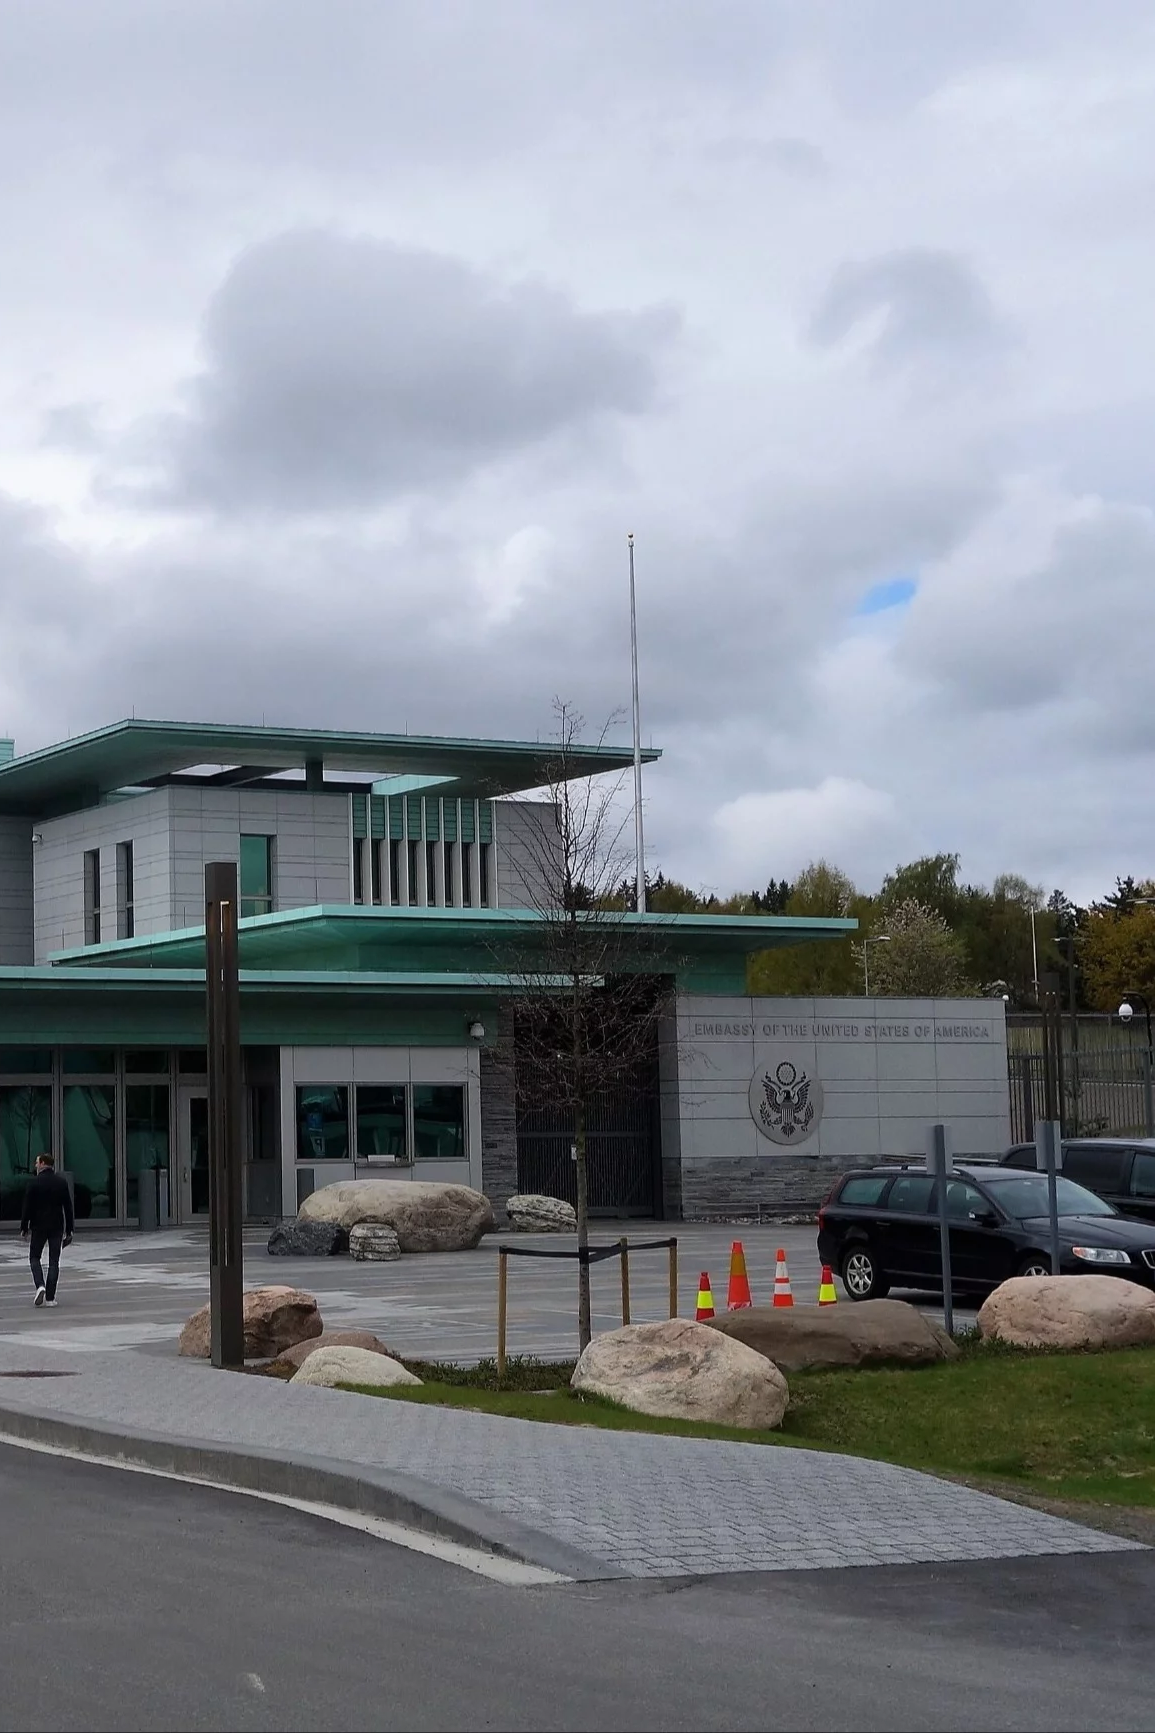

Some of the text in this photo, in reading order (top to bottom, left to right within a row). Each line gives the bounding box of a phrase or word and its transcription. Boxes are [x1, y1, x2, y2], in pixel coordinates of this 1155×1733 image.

[694, 1022, 989, 1038] EMBASSY OF THE UNITED STATES OF AMERICA
